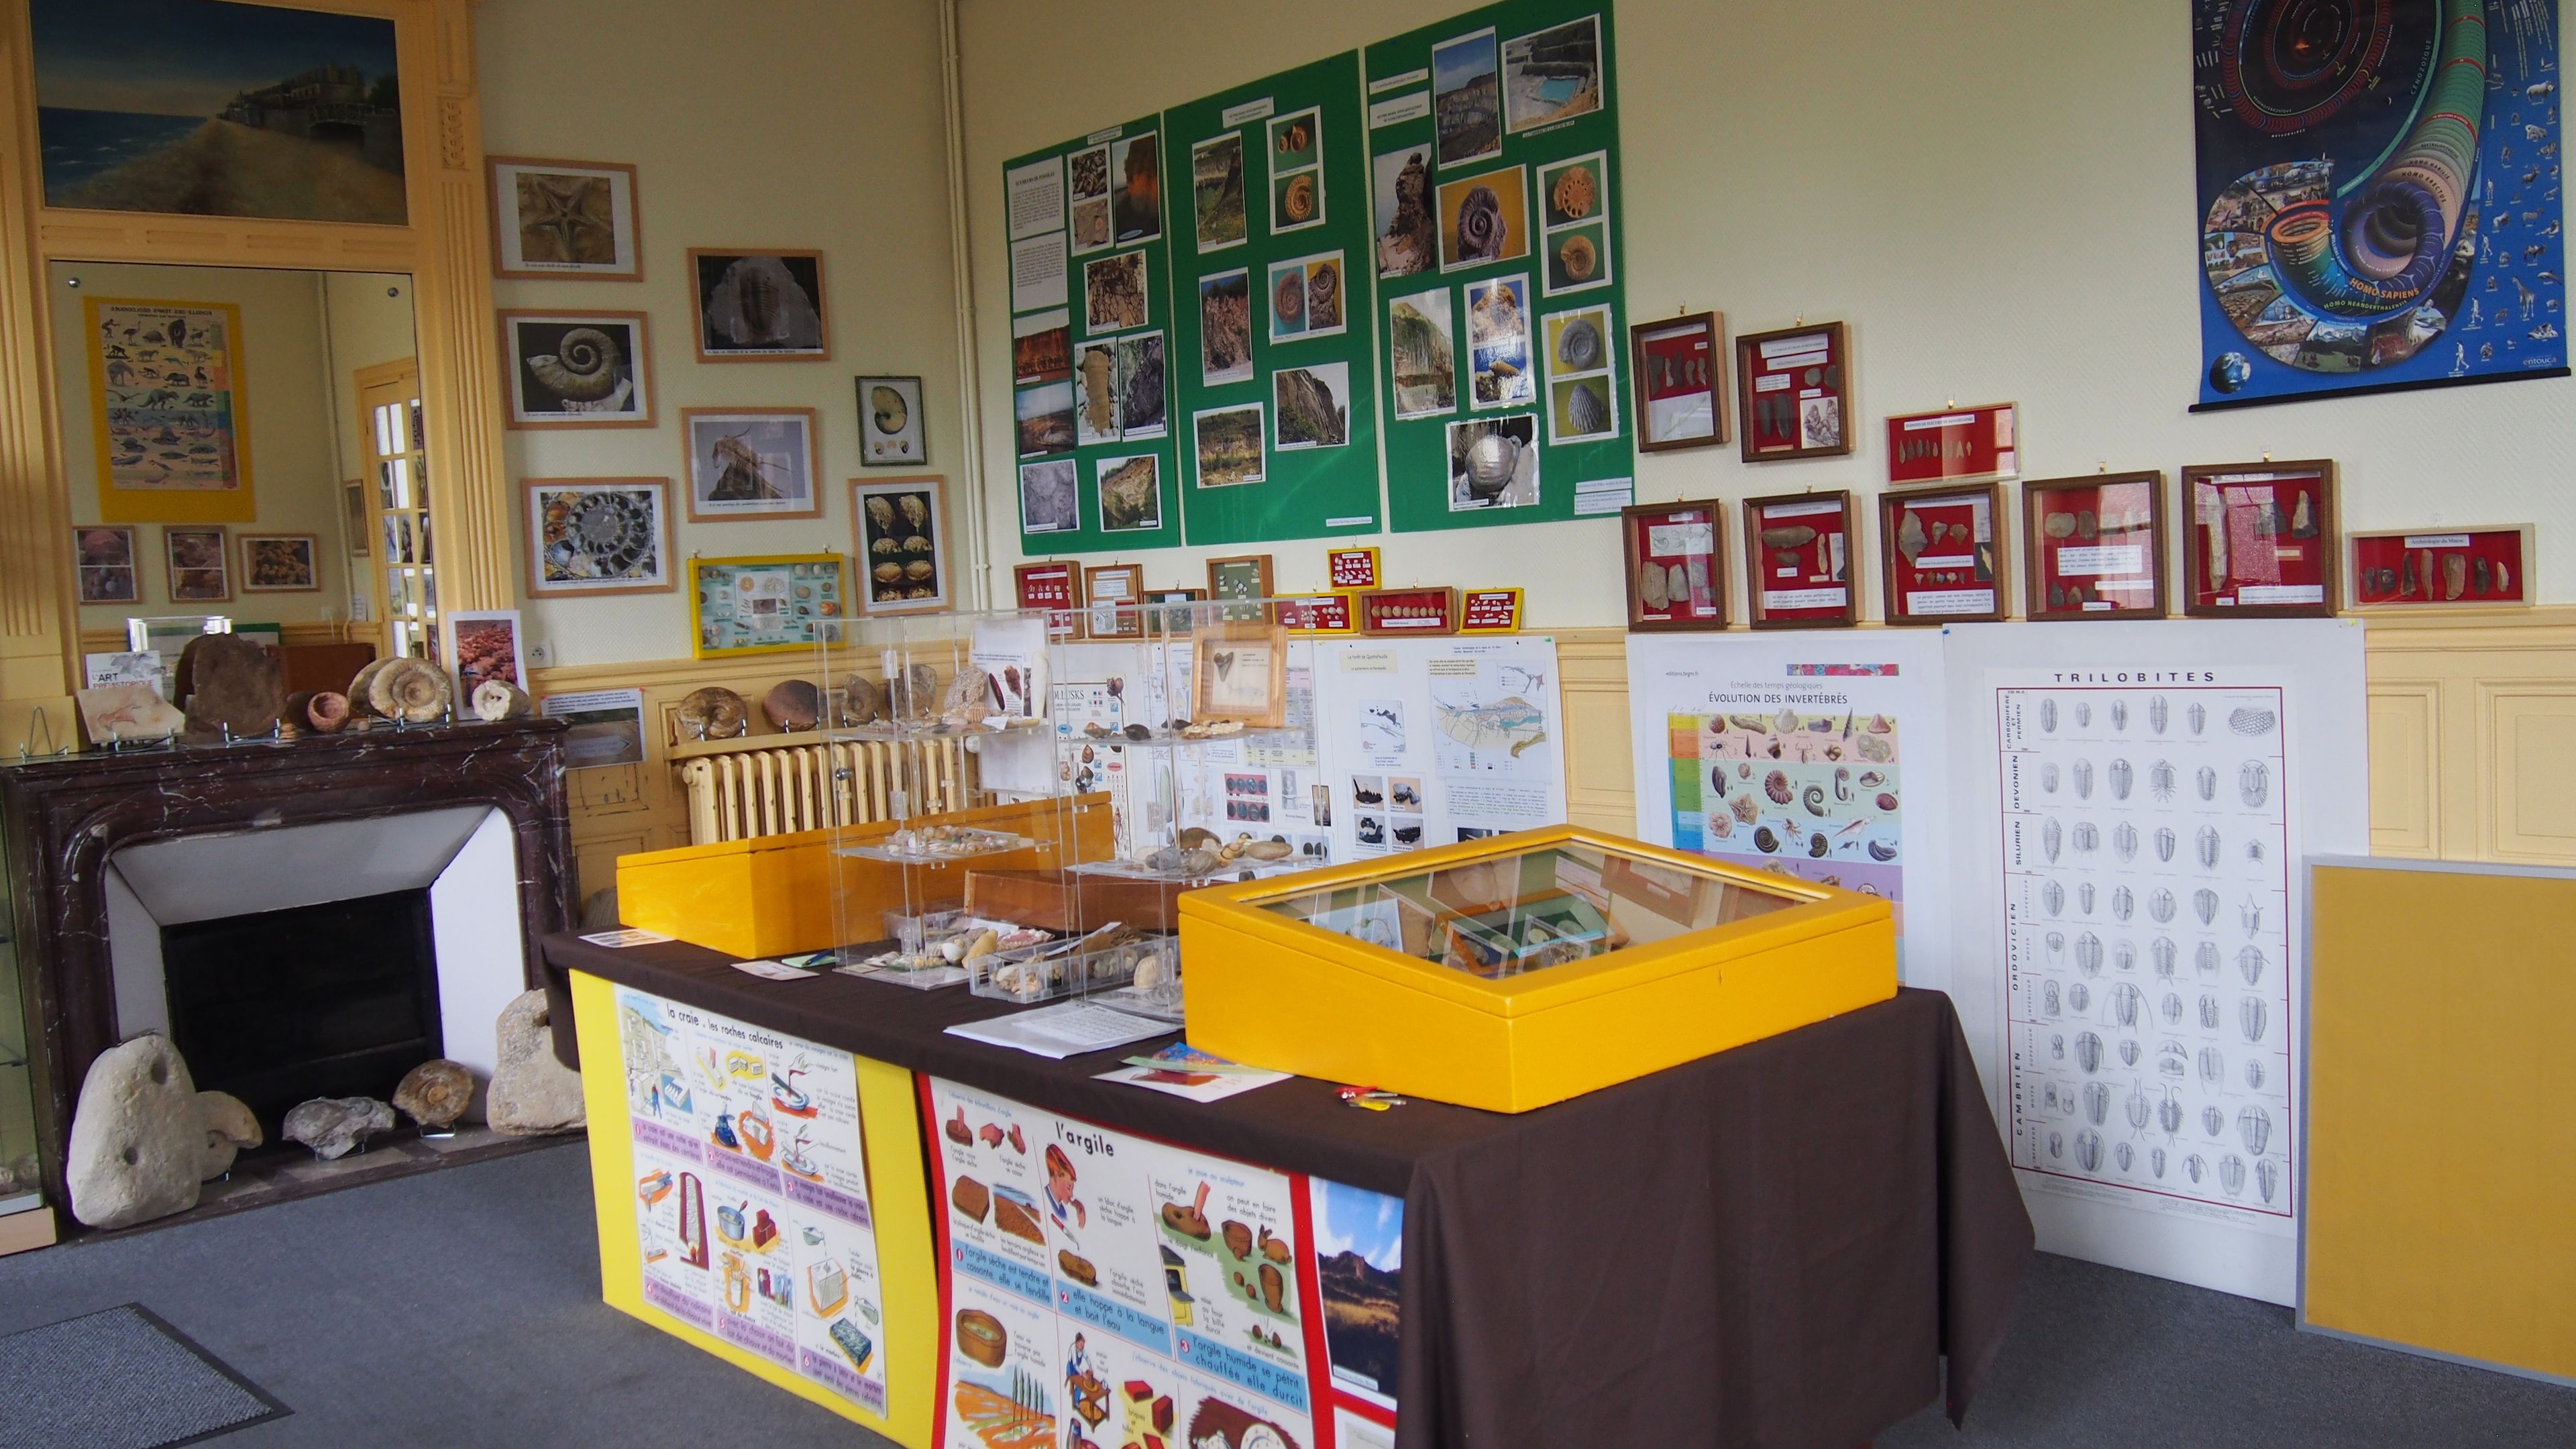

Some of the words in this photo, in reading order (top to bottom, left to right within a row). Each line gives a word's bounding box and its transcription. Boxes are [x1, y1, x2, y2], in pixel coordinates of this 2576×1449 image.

[2402, 170, 2424, 178] HOMO
[2425, 176, 2447, 203] ERECTUS
[2350, 277, 2379, 297] HOMO
[2380, 287, 2420, 299] SAPIENS
[2323, 300, 2345, 310] HOMO
[1730, 680, 1751, 688] Échelle
[1764, 682, 1784, 690] temps
[1785, 682, 1823, 690] géologiques
[2054, 672, 2214, 682] TRILOBITES
[1709, 691, 1761, 703] ÉVOLUTION
[1764, 694, 1781, 703] DES
[1785, 692, 1847, 704] INVERTÉBRÉS
[2010, 903, 2019, 991] ORDOVICIEN
[666, 1004, 676, 1018] la
[678, 1010, 700, 1026] craie
[708, 1018, 718, 1032] les
[721, 1024, 746, 1040] roches
[748, 1032, 784, 1050] calcaires
[2015, 1053, 2023, 1136] CAMBRIEN
[1055, 1121, 1114, 1157] l'argile
[1155, 1179, 1167, 1190] dans
[1169, 1182, 1187, 1196] l'argile
[1195, 1169, 1208, 1179] joue
[1220, 1175, 1245, 1188] sculpteur
[1227, 1205, 1238, 1214] des
[1239, 1208, 1256, 1221] objets
[1258, 1213, 1277, 1224] divers
[1237, 1196, 1250, 1208] peut
[1262, 1201, 1277, 1214] faire
[965, 1244, 987, 1263] l'argile
[988, 1255, 1006, 1271] sèche
[1008, 1263, 1018, 1275] est
[1018, 1267, 1042, 1285] tendre
[1042, 1276, 1049, 1287] et
[999, 1273, 1011, 1287] elle
[1014, 1281, 1022, 1291] se
[1025, 1281, 1051, 1303] fendille
[1073, 1289, 1086, 1303] elle
[1089, 1293, 1114, 1320] happe
[1126, 1307, 1134, 1322] la
[1136, 1311, 1165, 1335] langue
[1074, 1305, 1082, 1316] et
[1085, 1305, 1099, 1322] boit
[1102, 1312, 1121, 1332] l'eau
[1203, 1313, 1209, 1323] la
[1212, 1316, 1225, 1328] bille
[1193, 1336, 1222, 1358] l'argile
[1226, 1348, 1256, 1373] humide
[1262, 1367, 1271, 1378] se
[1254, 1346, 1274, 1360] devient
[1276, 1356, 1300, 1370] cassante
[1195, 1354, 1240, 1381] chauffée
[1246, 1377, 1266, 1391] elle
[1273, 1387, 1303, 1407] durcit
[1247, 1399, 1269, 1416] l'argile
